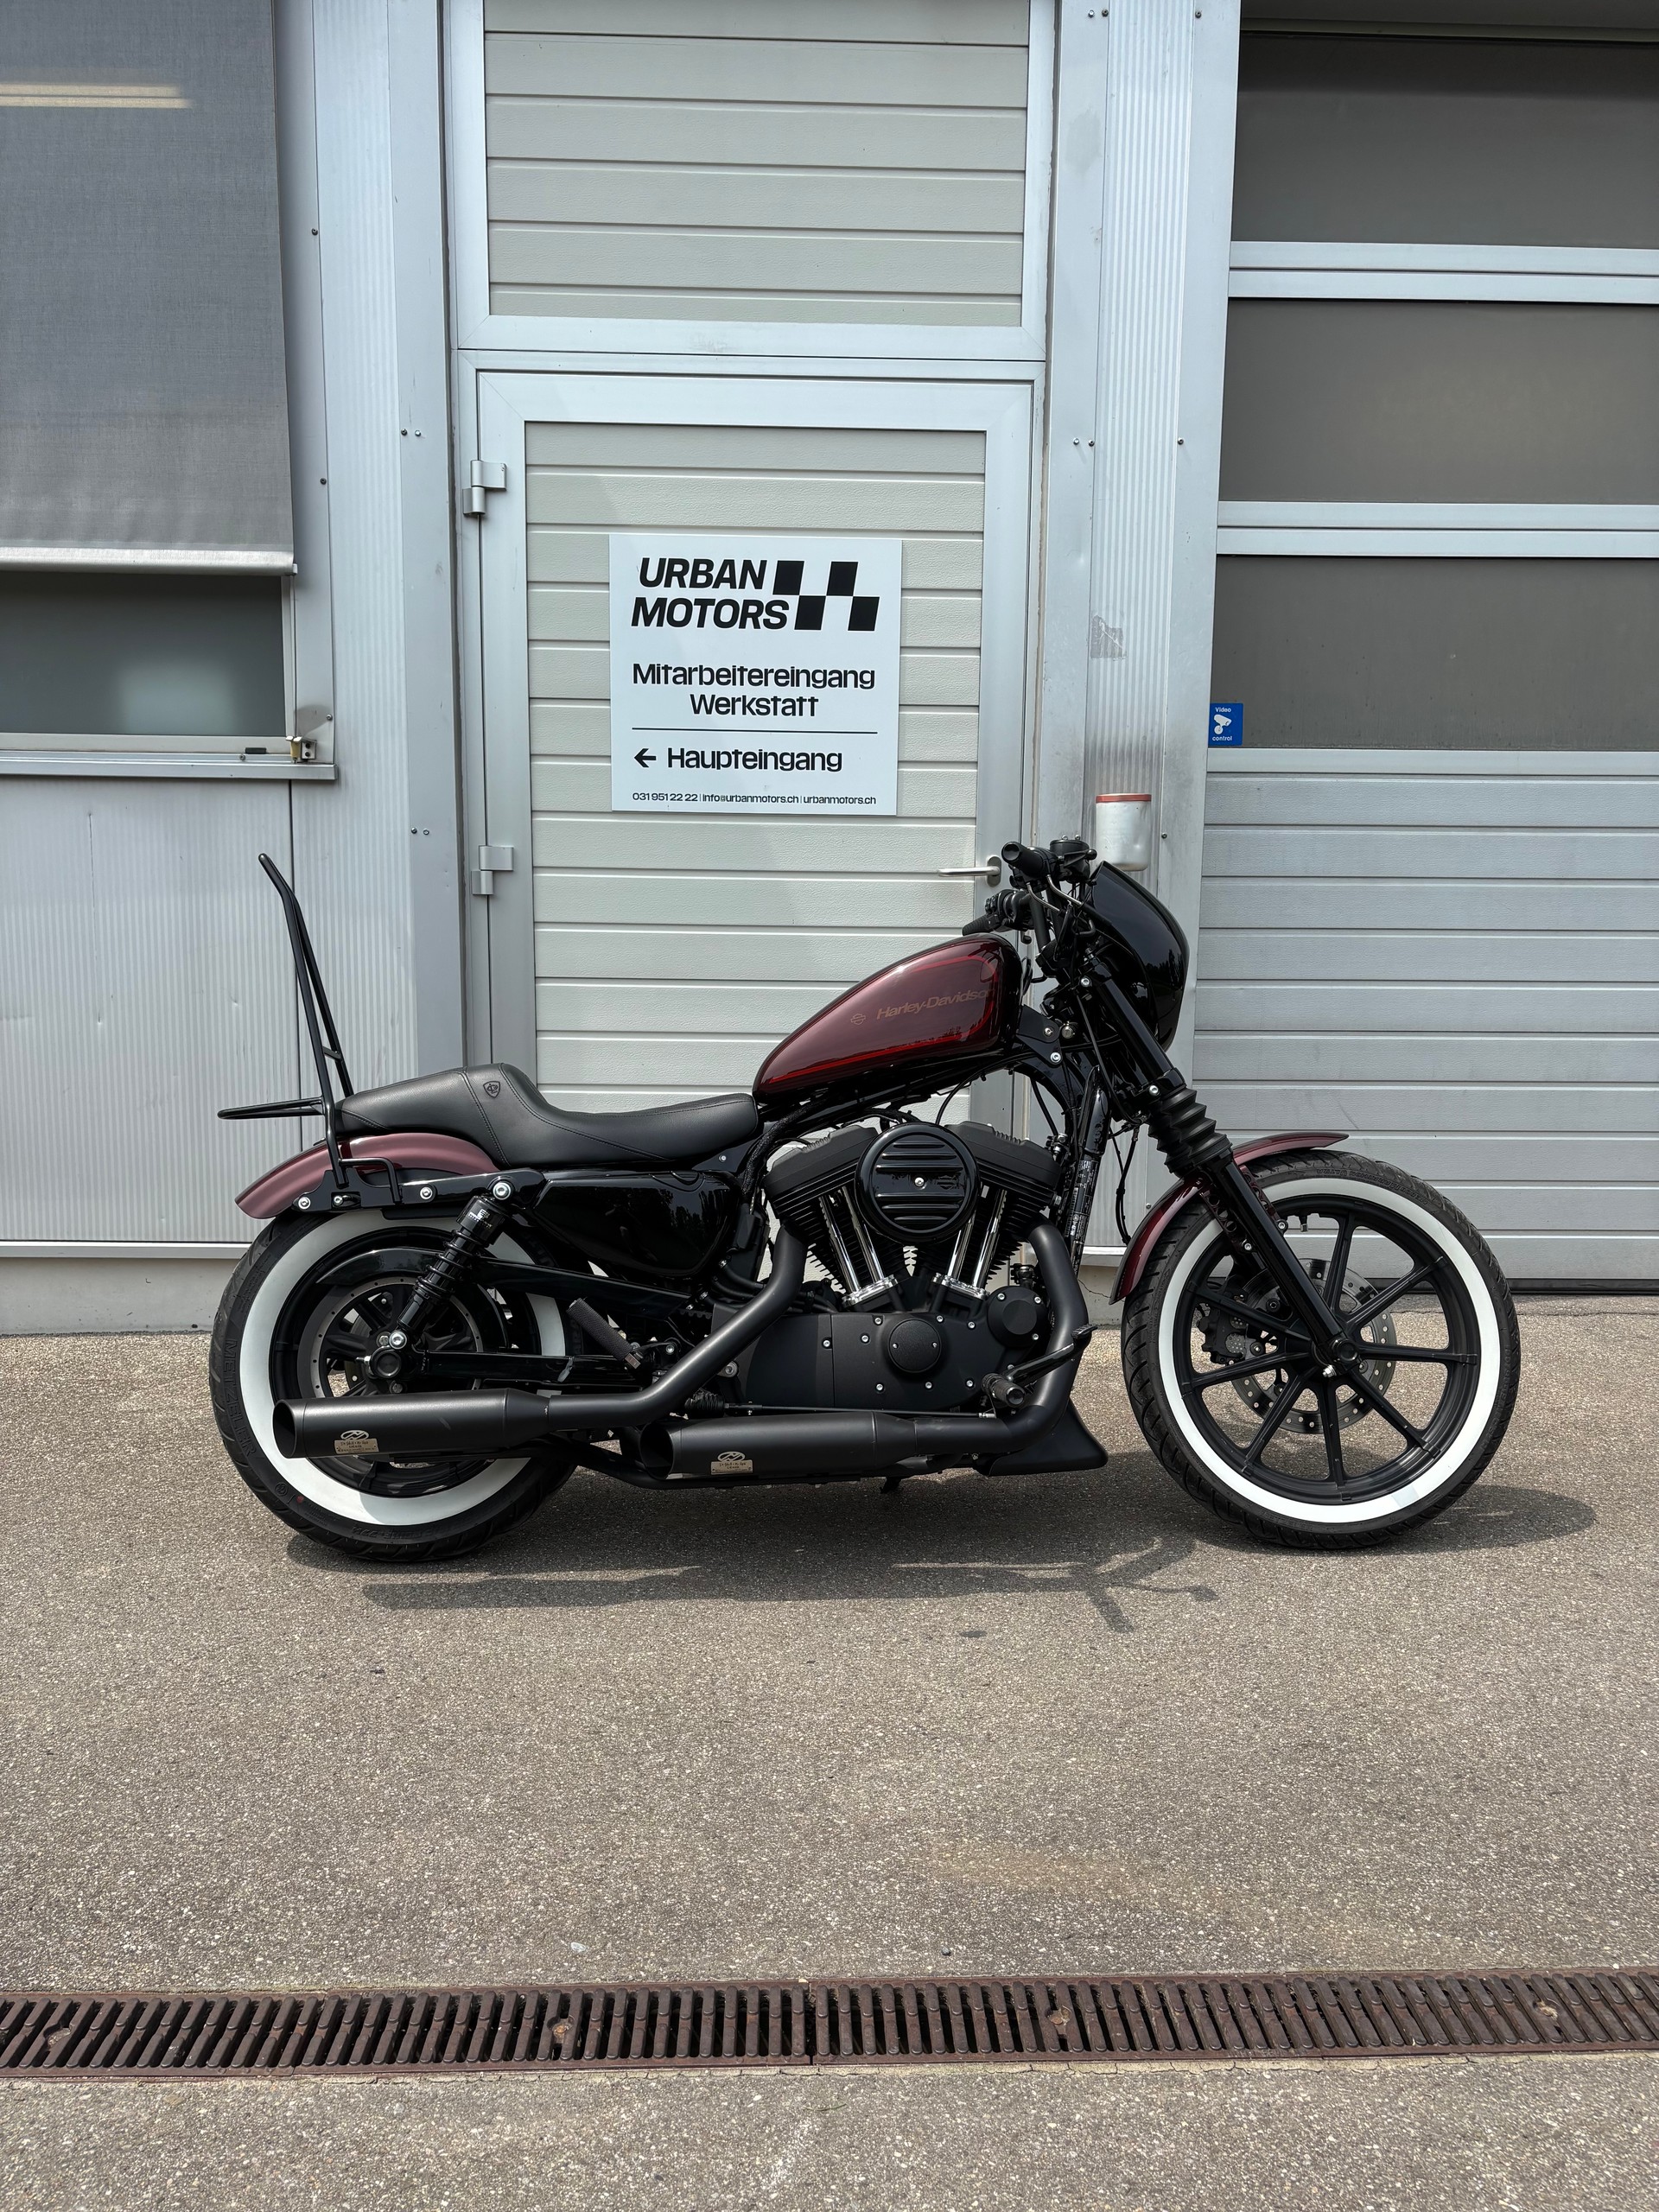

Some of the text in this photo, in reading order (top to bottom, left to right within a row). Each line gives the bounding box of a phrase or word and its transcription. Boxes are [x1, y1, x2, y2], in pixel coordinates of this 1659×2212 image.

[639, 557, 768, 590] URBAN
[631, 596, 790, 630] MOTORS
[632, 663, 875, 690] Mitarbeitereingang
[690, 693, 819, 717] Werkstatt
[667, 747, 842, 772] Haupteingang
[684, 793, 698, 802] 22
[803, 795, 876, 804] urbanmotors.ch
[223, 1338, 257, 1458] METZELER
